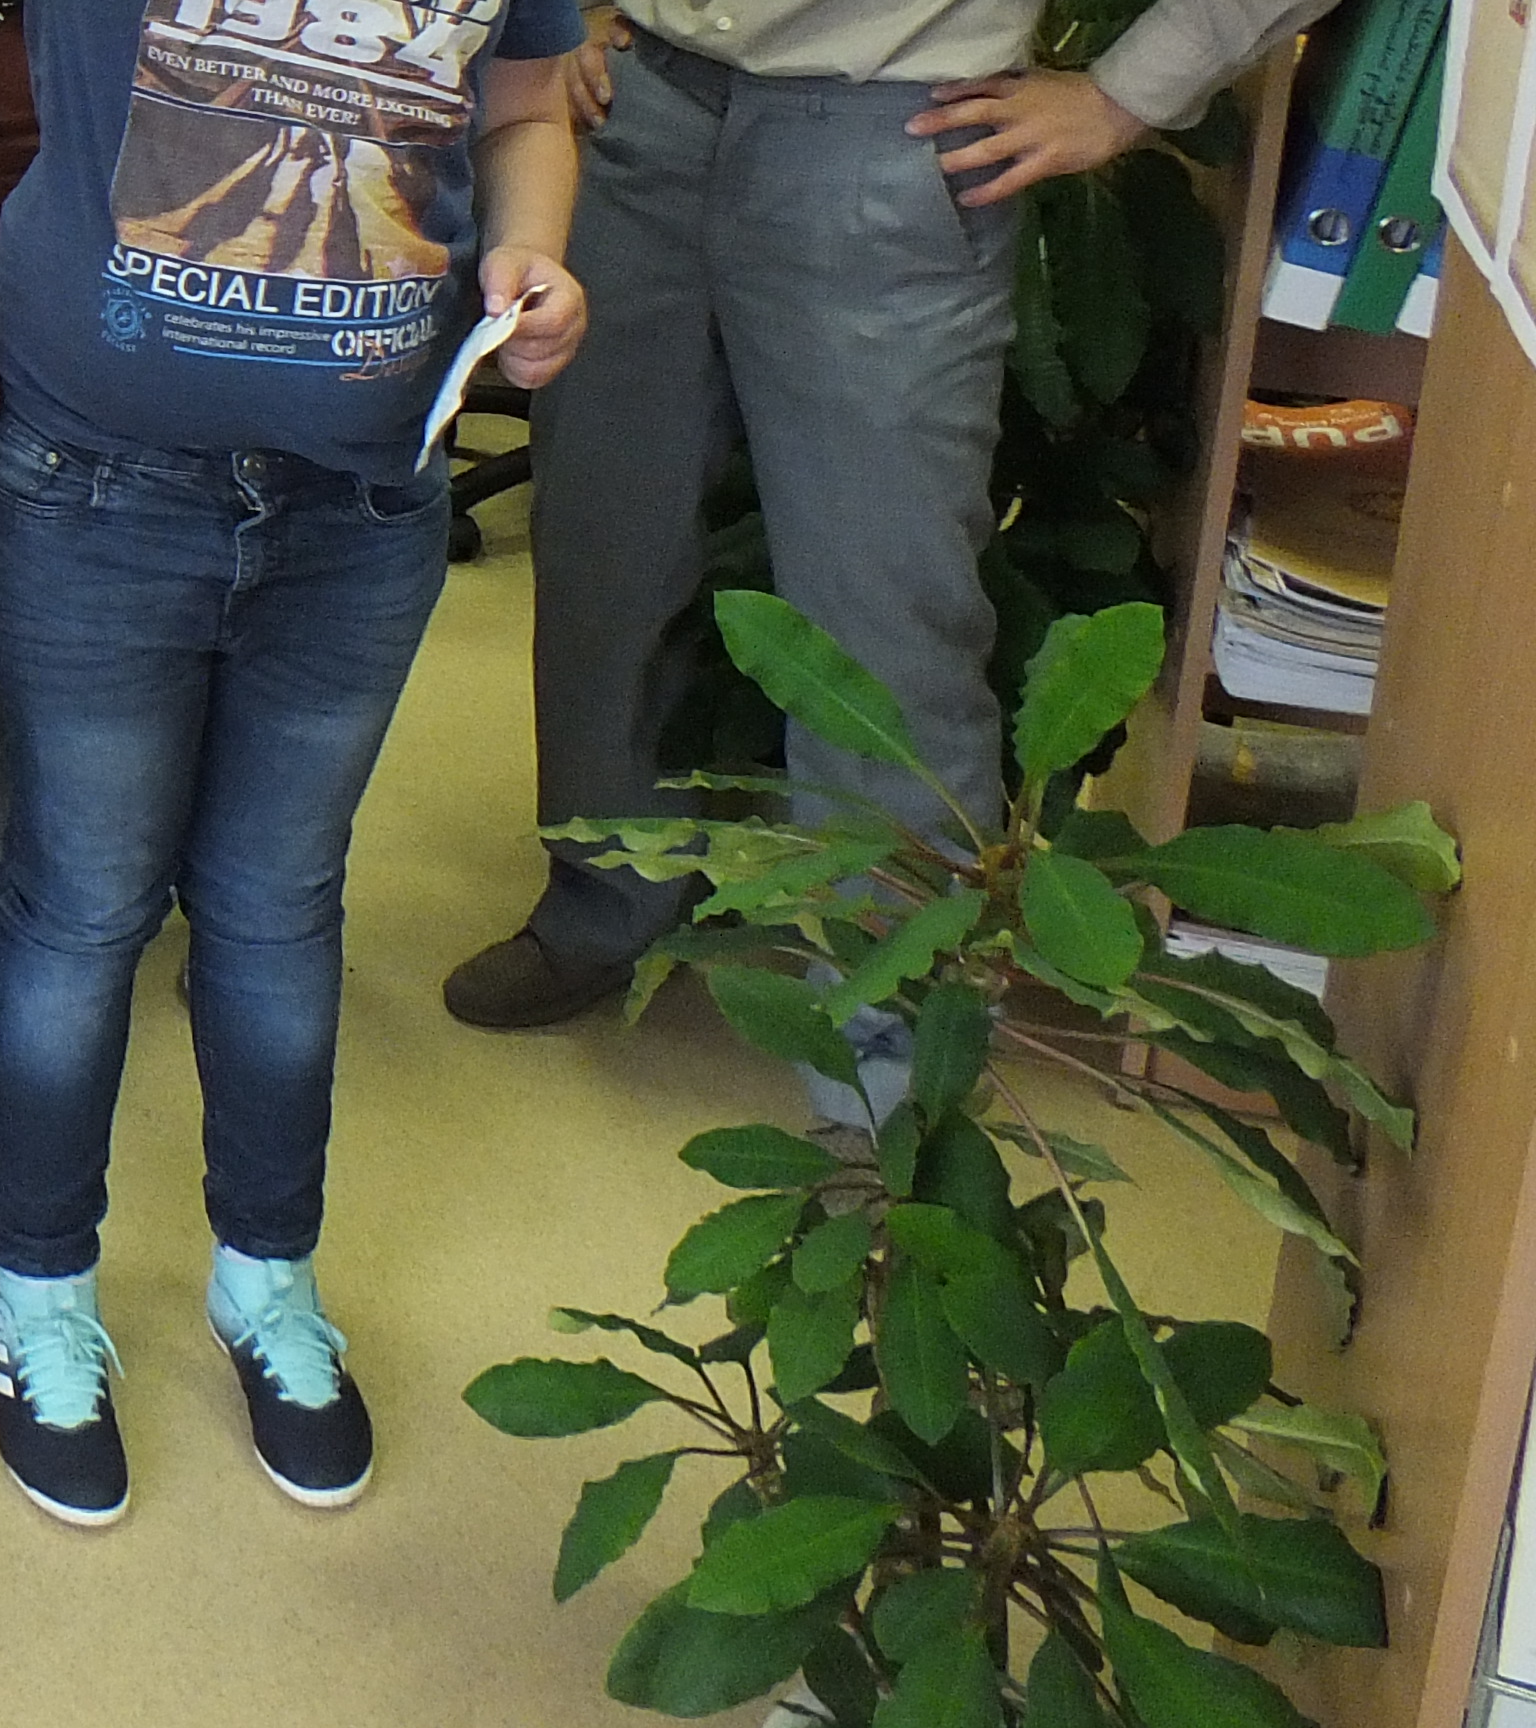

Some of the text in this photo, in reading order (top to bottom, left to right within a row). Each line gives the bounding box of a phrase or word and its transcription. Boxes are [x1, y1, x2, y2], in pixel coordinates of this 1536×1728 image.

[147, 46, 453, 129] EVEN BETTER AND MORE EXCITING
[251, 87, 362, 126] THAN EVER!
[106, 244, 442, 319] SPECIAL EDITION
[161, 328, 297, 356] international record
[163, 312, 332, 343] celebrates his impressive
